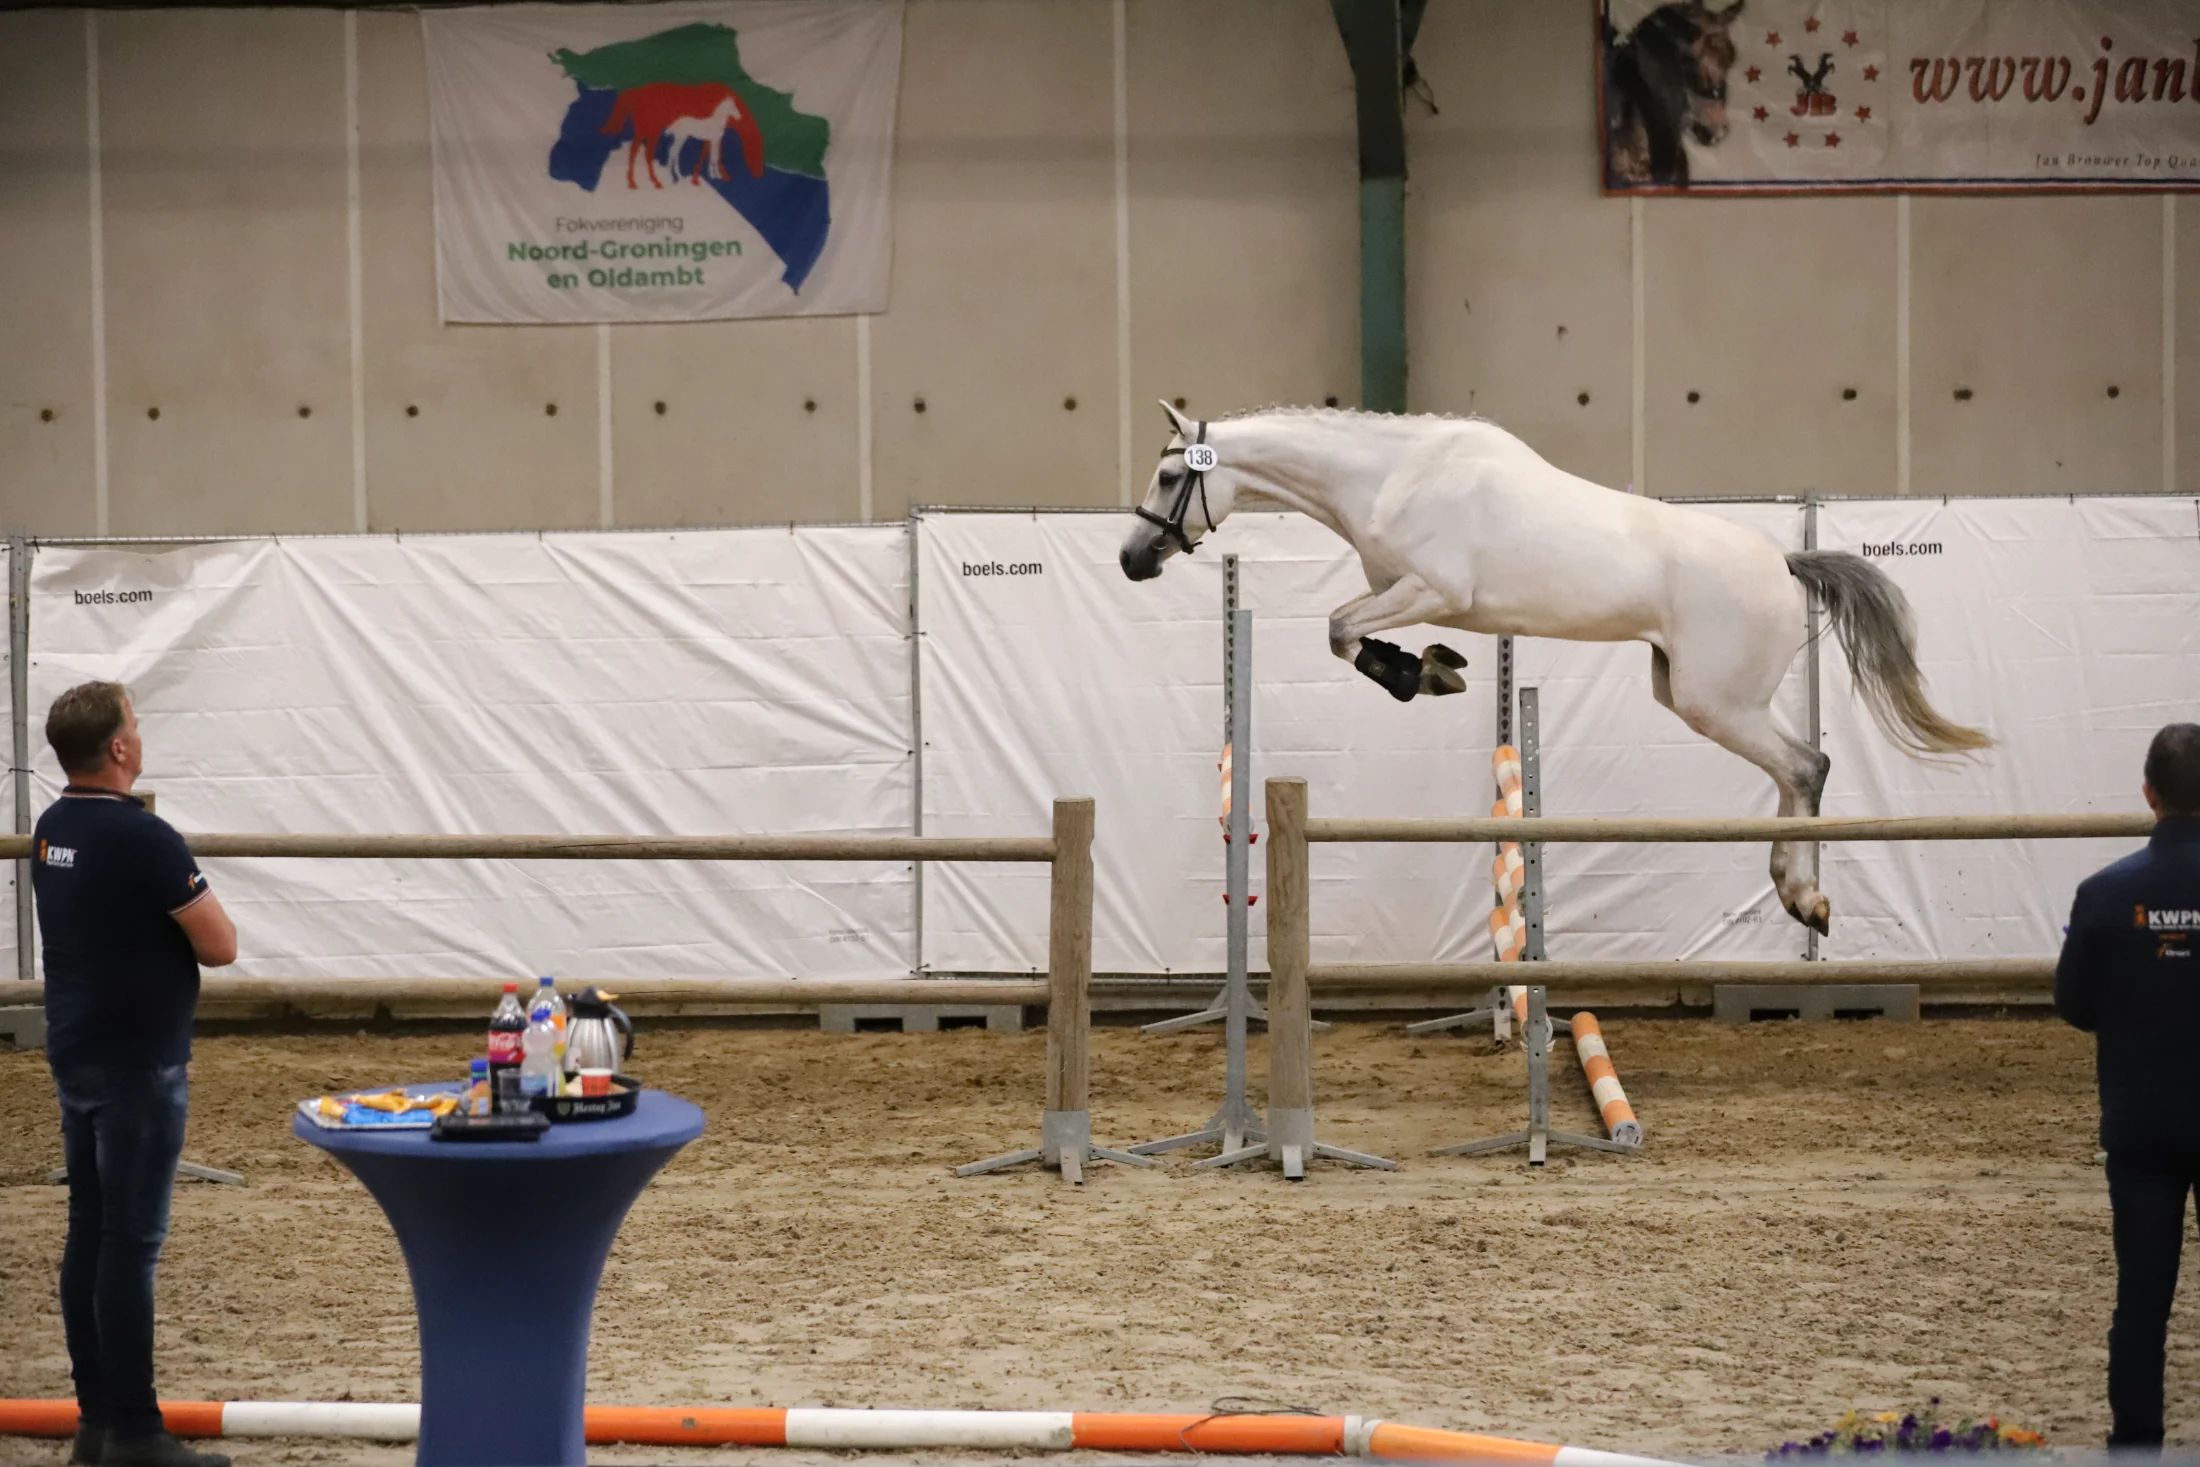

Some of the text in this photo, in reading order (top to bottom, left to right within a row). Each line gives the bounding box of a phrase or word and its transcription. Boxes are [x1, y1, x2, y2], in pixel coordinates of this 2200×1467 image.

[2136, 154, 2161, 169] Top
[2168, 154, 2200, 169] Qua
[555, 215, 685, 233] Fokvereniging
[508, 237, 742, 262] Noord-Groningen
[547, 266, 705, 288] en Oldambt
[1187, 449, 1213, 466] 138
[1862, 541, 1943, 557] boels.com
[962, 561, 1043, 576] boels.com
[74, 589, 153, 605] boels.com
[47, 845, 76, 863] KWPN
